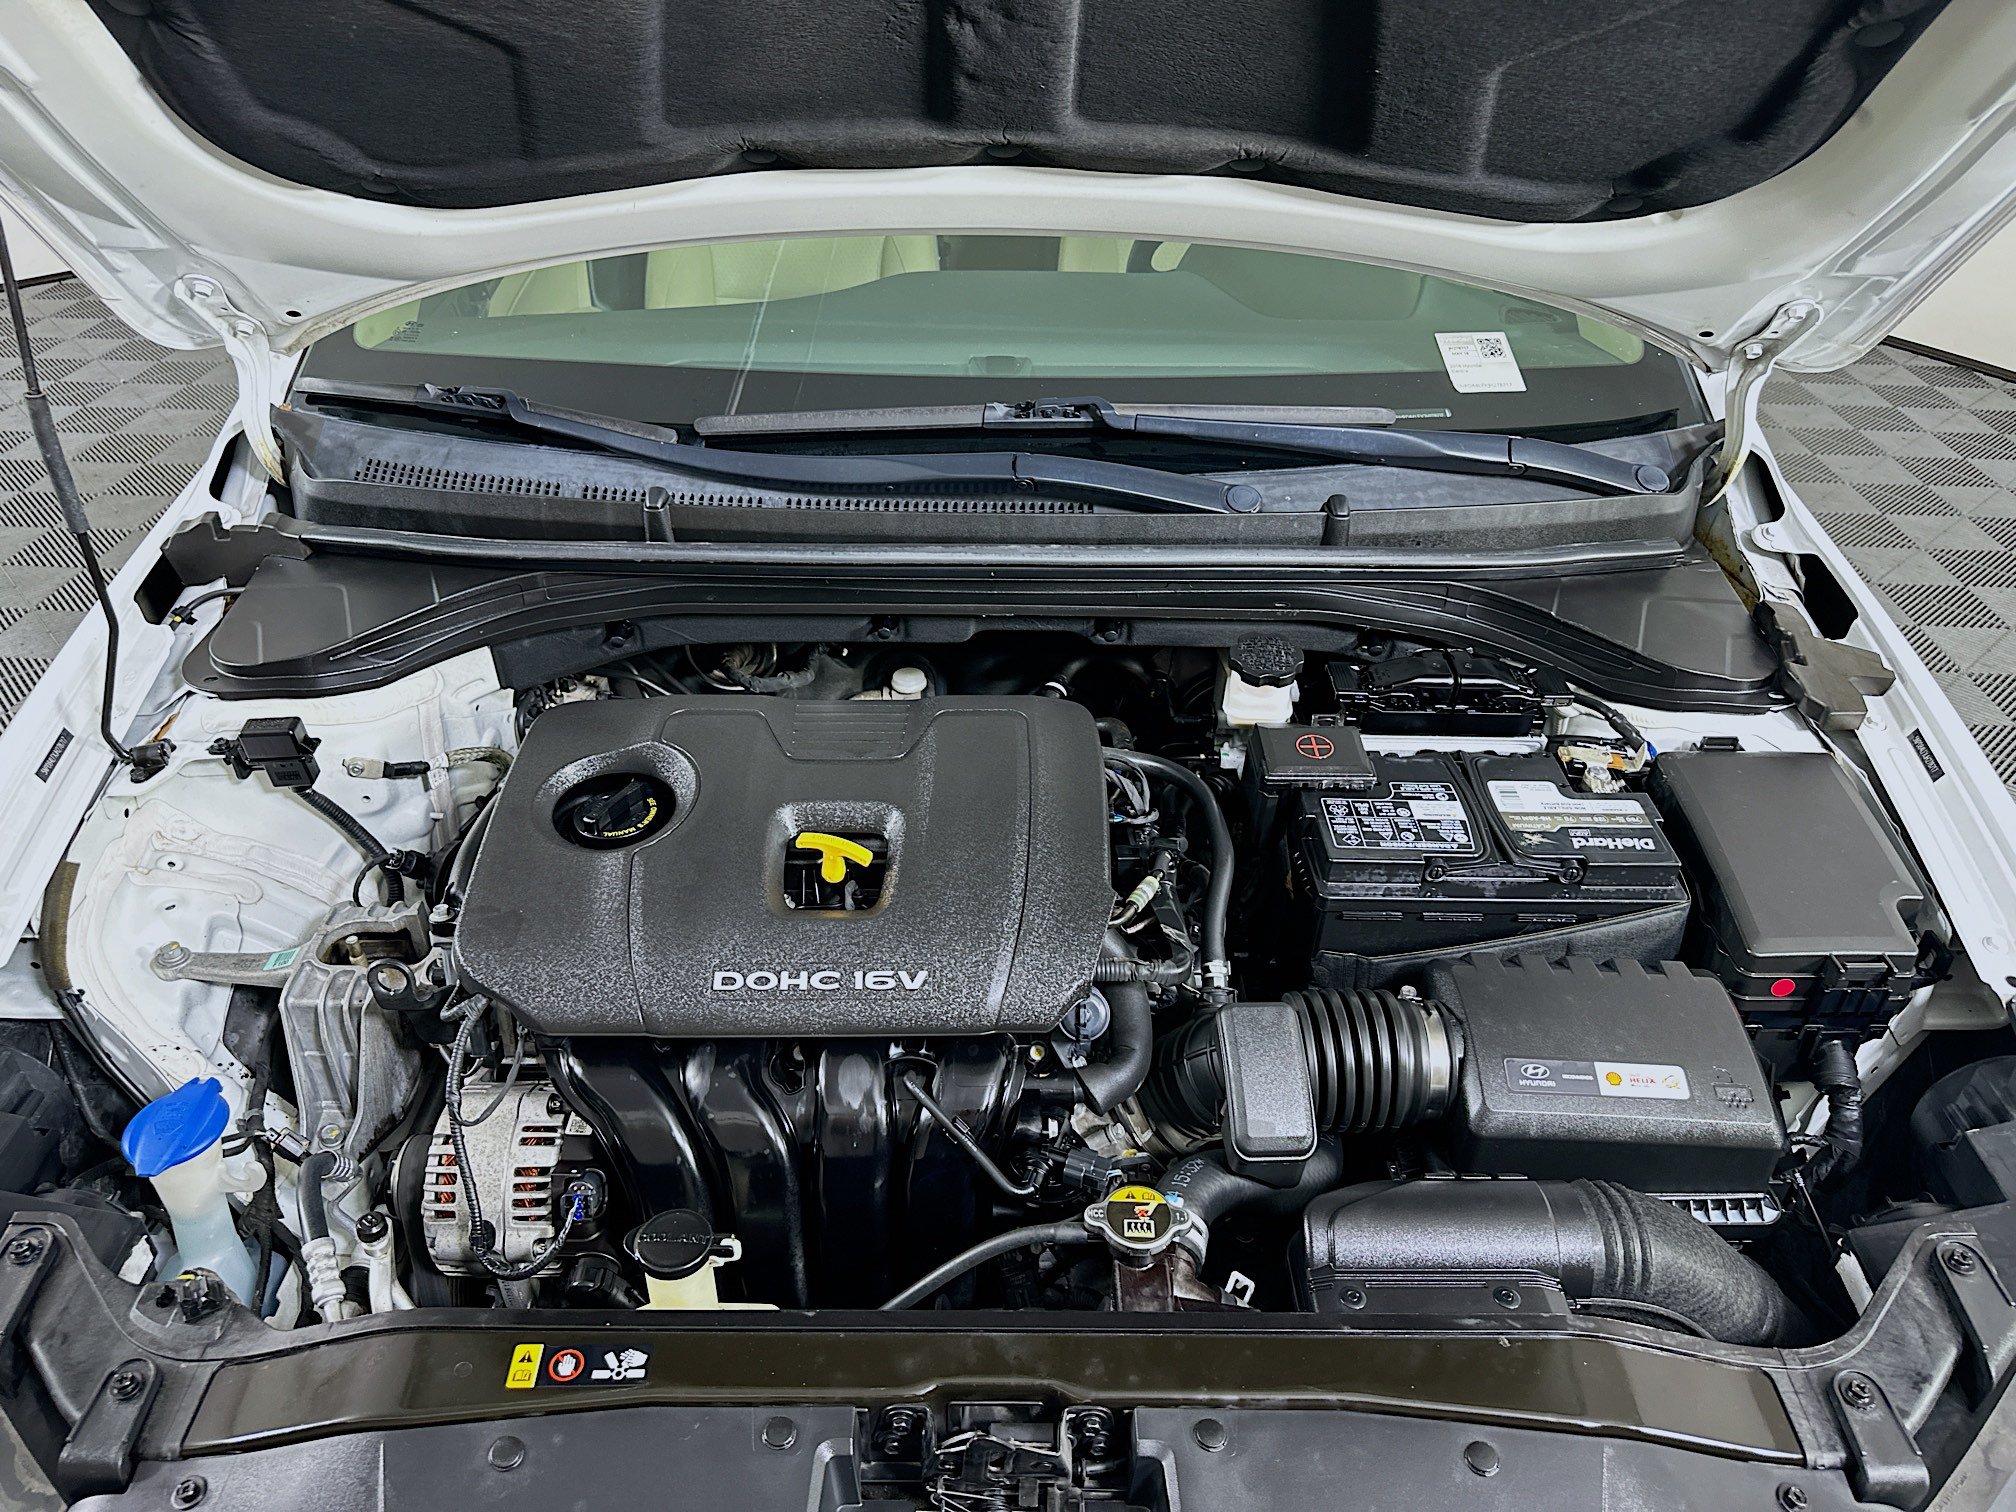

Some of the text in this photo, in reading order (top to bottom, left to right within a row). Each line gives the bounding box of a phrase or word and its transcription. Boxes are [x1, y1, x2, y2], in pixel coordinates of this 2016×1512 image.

[602, 826, 637, 837] MANUAL
[1571, 836, 1655, 850] DieHard
[712, 970, 928, 991] DOHC 16V
[1519, 1079, 1556, 1087] HYUNDAI
[1087, 1208, 1105, 1218] HCC
[1175, 1212, 1188, 1221] 1.1
[637, 1232, 710, 1244] COOLANT
